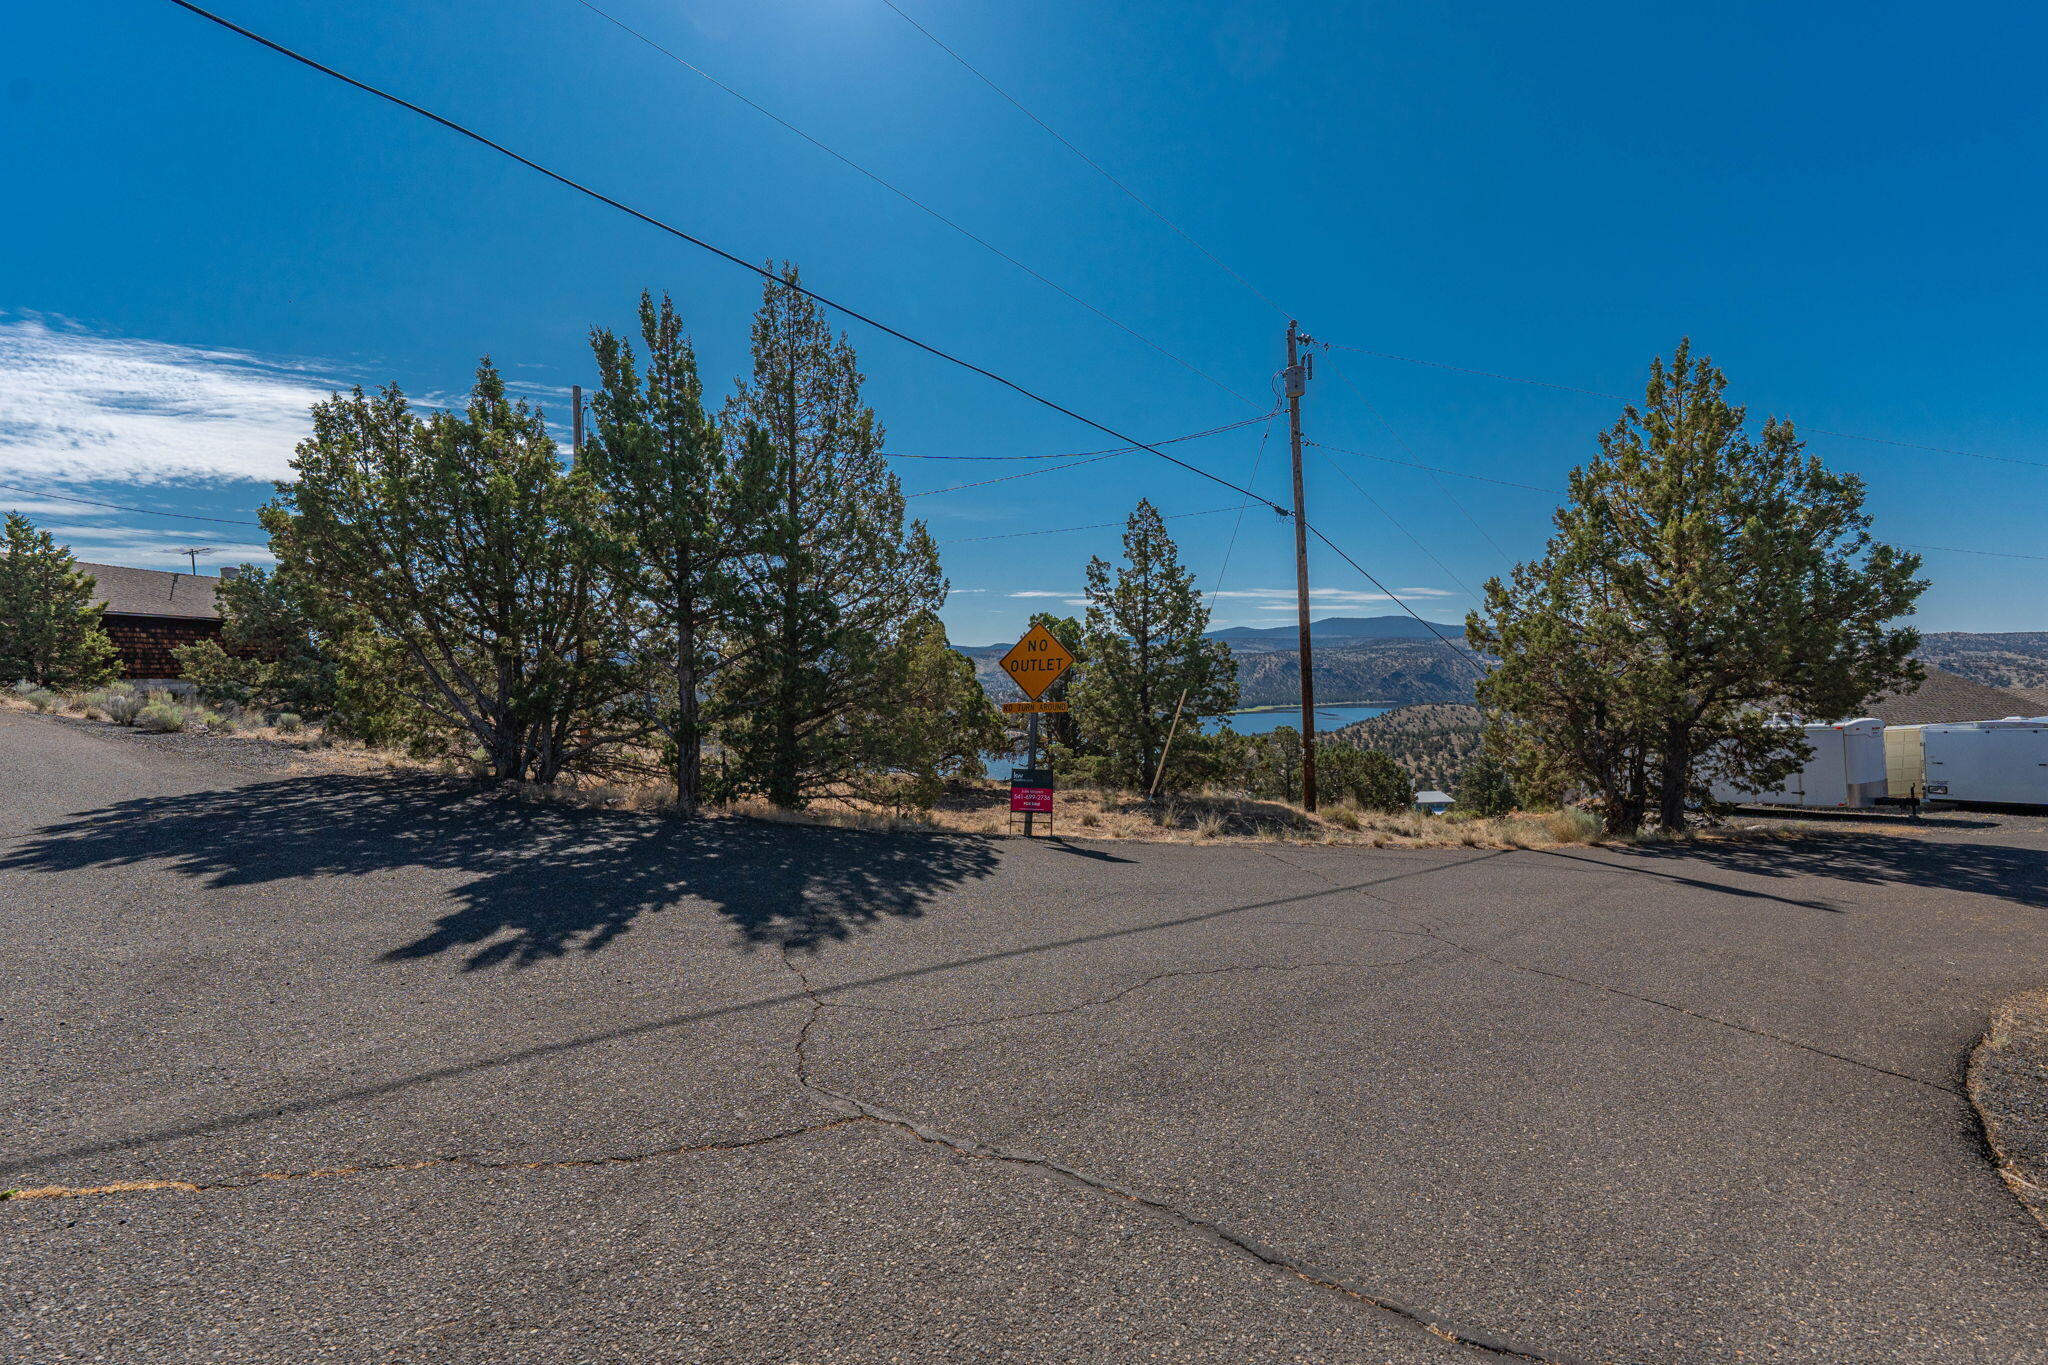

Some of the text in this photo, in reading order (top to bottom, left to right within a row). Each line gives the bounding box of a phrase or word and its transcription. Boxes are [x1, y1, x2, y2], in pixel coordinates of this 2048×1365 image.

[1028, 639, 1048, 652] NO
[1011, 658, 1063, 672] OUTLET
[1003, 702, 1066, 712] NO TURN AROUND
